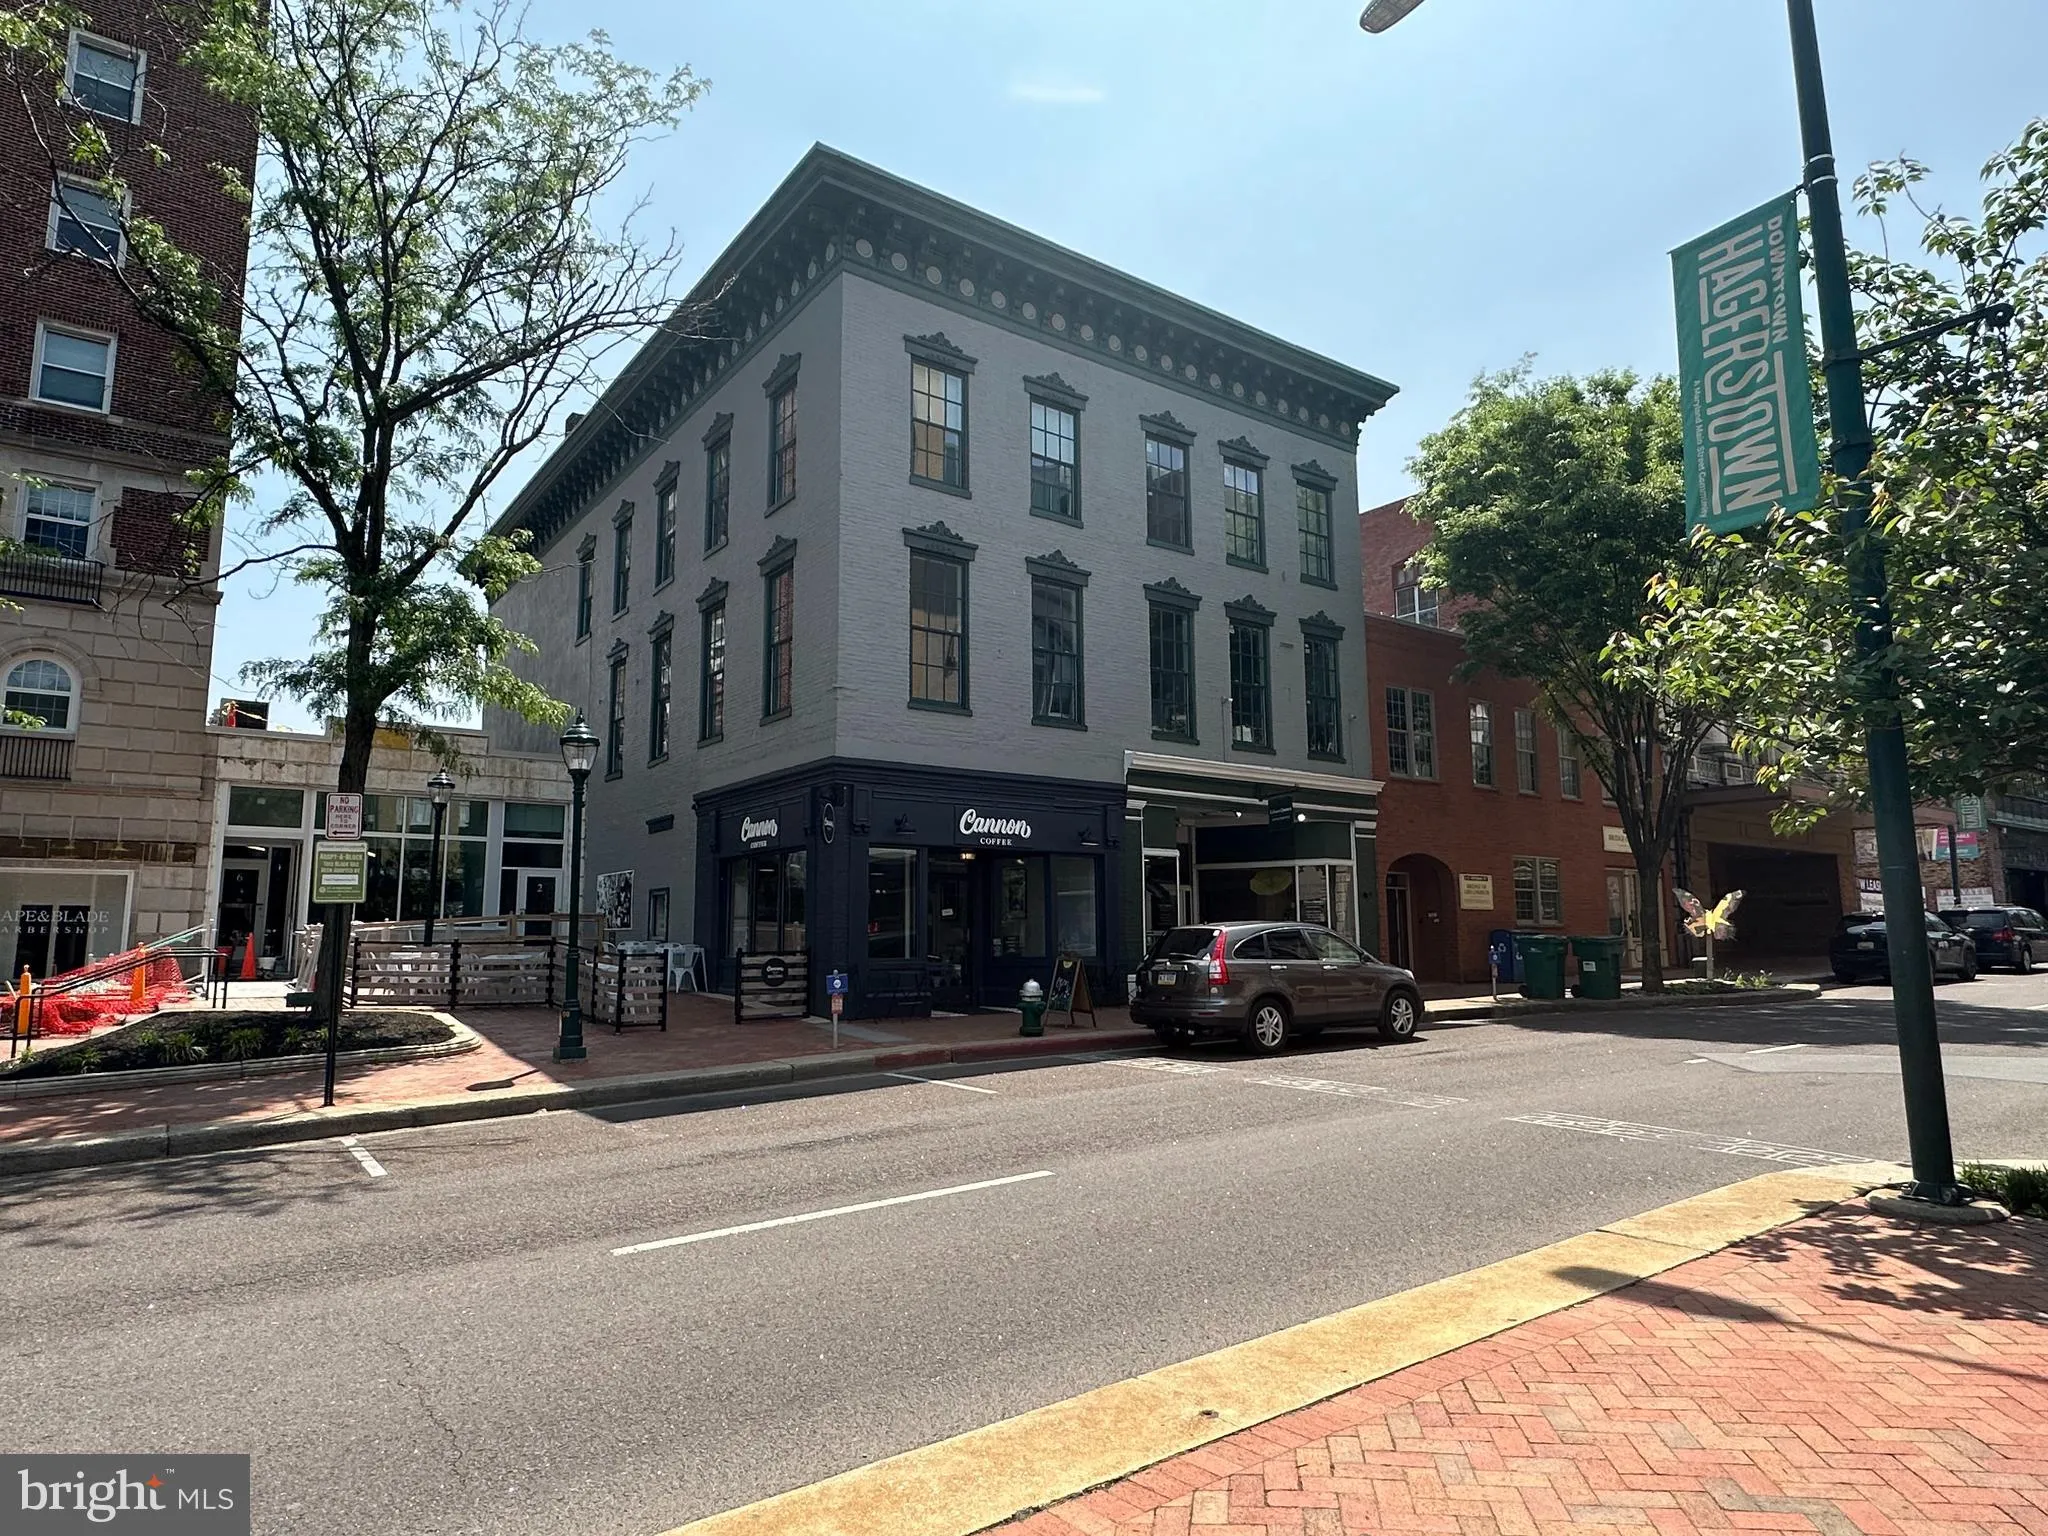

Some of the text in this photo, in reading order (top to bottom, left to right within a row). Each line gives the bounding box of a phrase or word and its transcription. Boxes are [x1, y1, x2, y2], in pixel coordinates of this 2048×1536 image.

[1767, 214, 1788, 344] DOWNTOWN
[1698, 224, 1783, 512] HAGERSTOWN
[1693, 387, 1704, 424] Maryland
[1695, 424, 1705, 445] Main
[1697, 446, 1707, 472] Street
[1698, 472, 1709, 518] Community
[329, 805, 359, 814] PARKING
[339, 796, 350, 804] NO
[740, 816, 778, 842] Cannon
[959, 808, 1032, 839] Cannon
[750, 840, 767, 849] COFFEE
[979, 837, 1013, 846] COFFEE
[536, 883, 543, 893] 2
